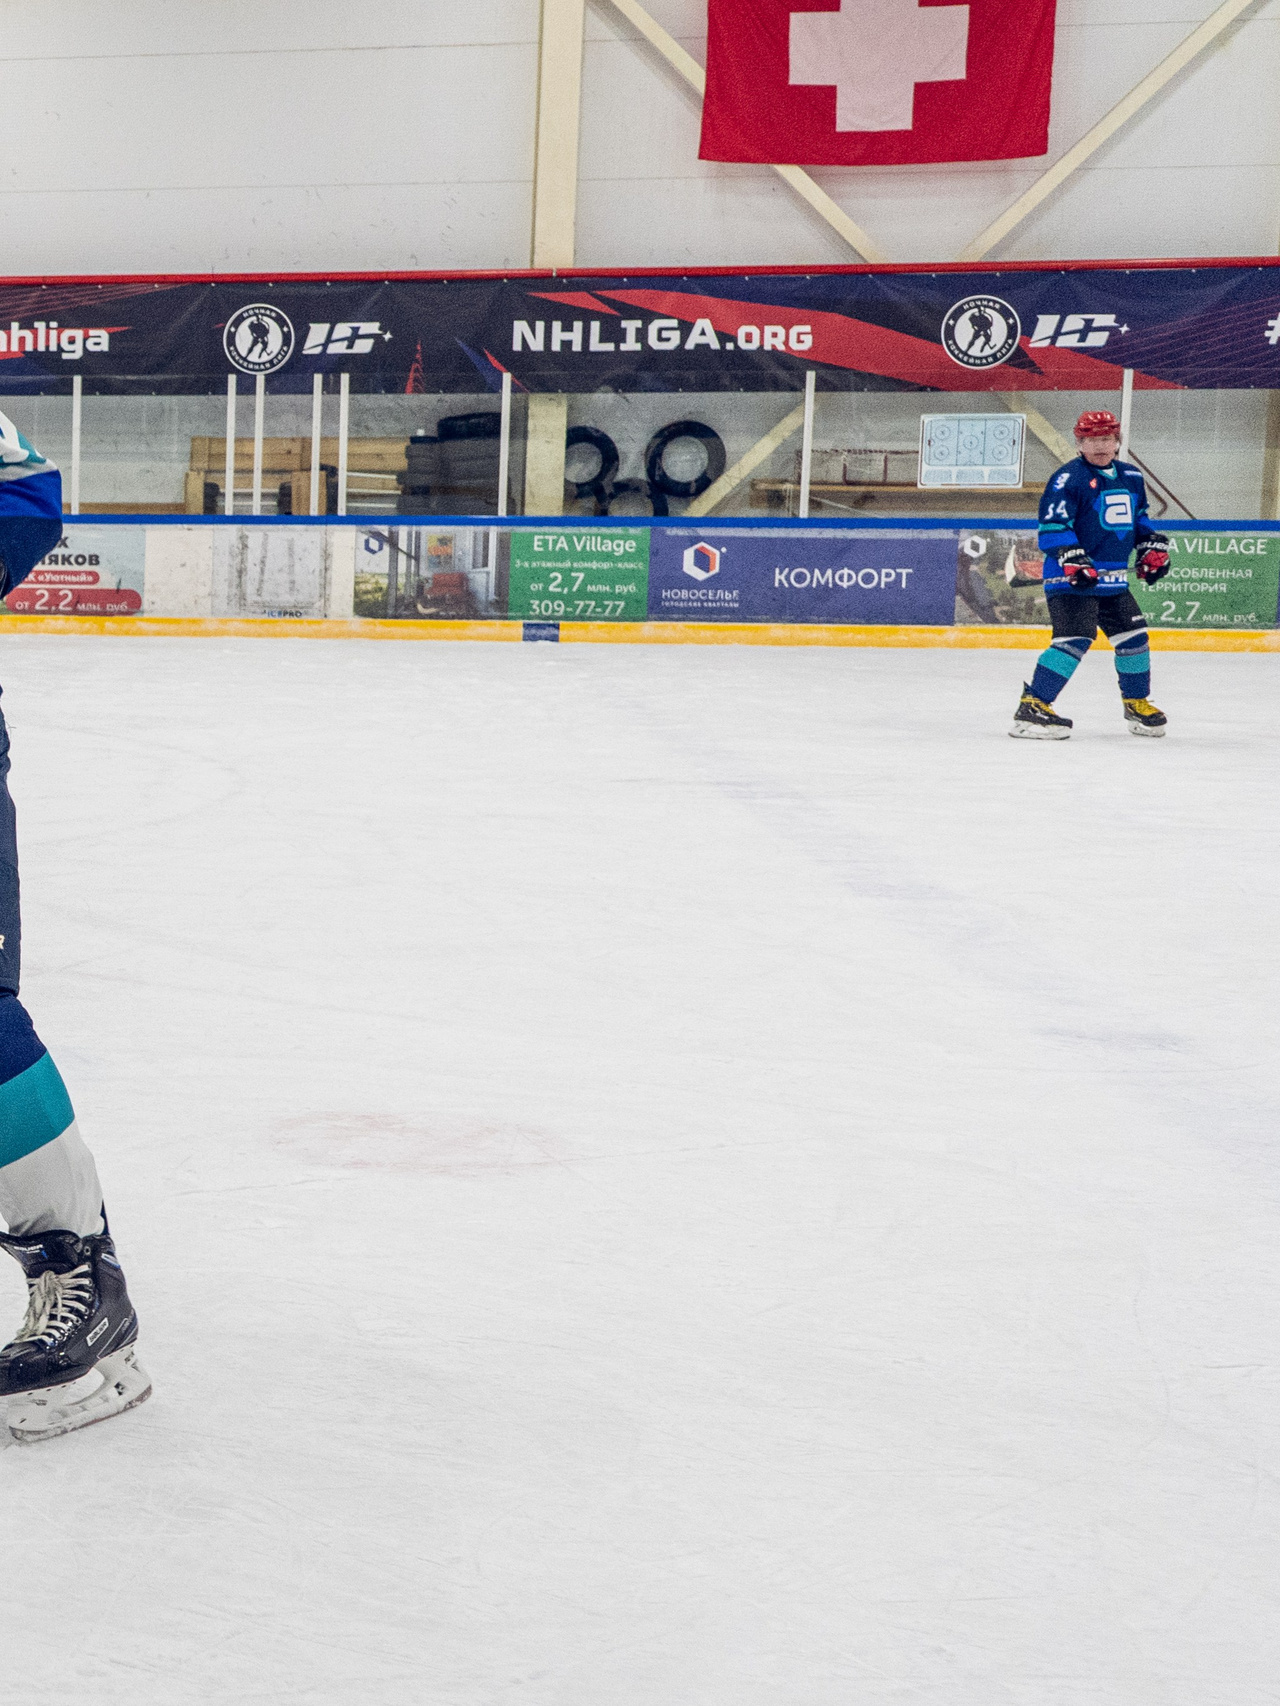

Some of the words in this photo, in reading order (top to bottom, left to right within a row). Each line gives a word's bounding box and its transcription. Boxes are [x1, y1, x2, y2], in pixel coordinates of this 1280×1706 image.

[962, 299, 1002, 311] НОЧНАЯ
[512, 318, 814, 352] NHLIGA.ORG
[533, 535, 569, 552] ETA
[573, 535, 637, 556] Village
[1183, 538, 1268, 555] VILLAGE
[530, 583, 545, 592] от
[548, 571, 585, 595] 2,7
[774, 567, 914, 589] КОМФОРТ
[661, 589, 740, 600] НОВОСЕЛЬЕ
[1140, 582, 1228, 593] ТЕРРИТОРИЯ
[529, 599, 626, 617] 309-77-77
